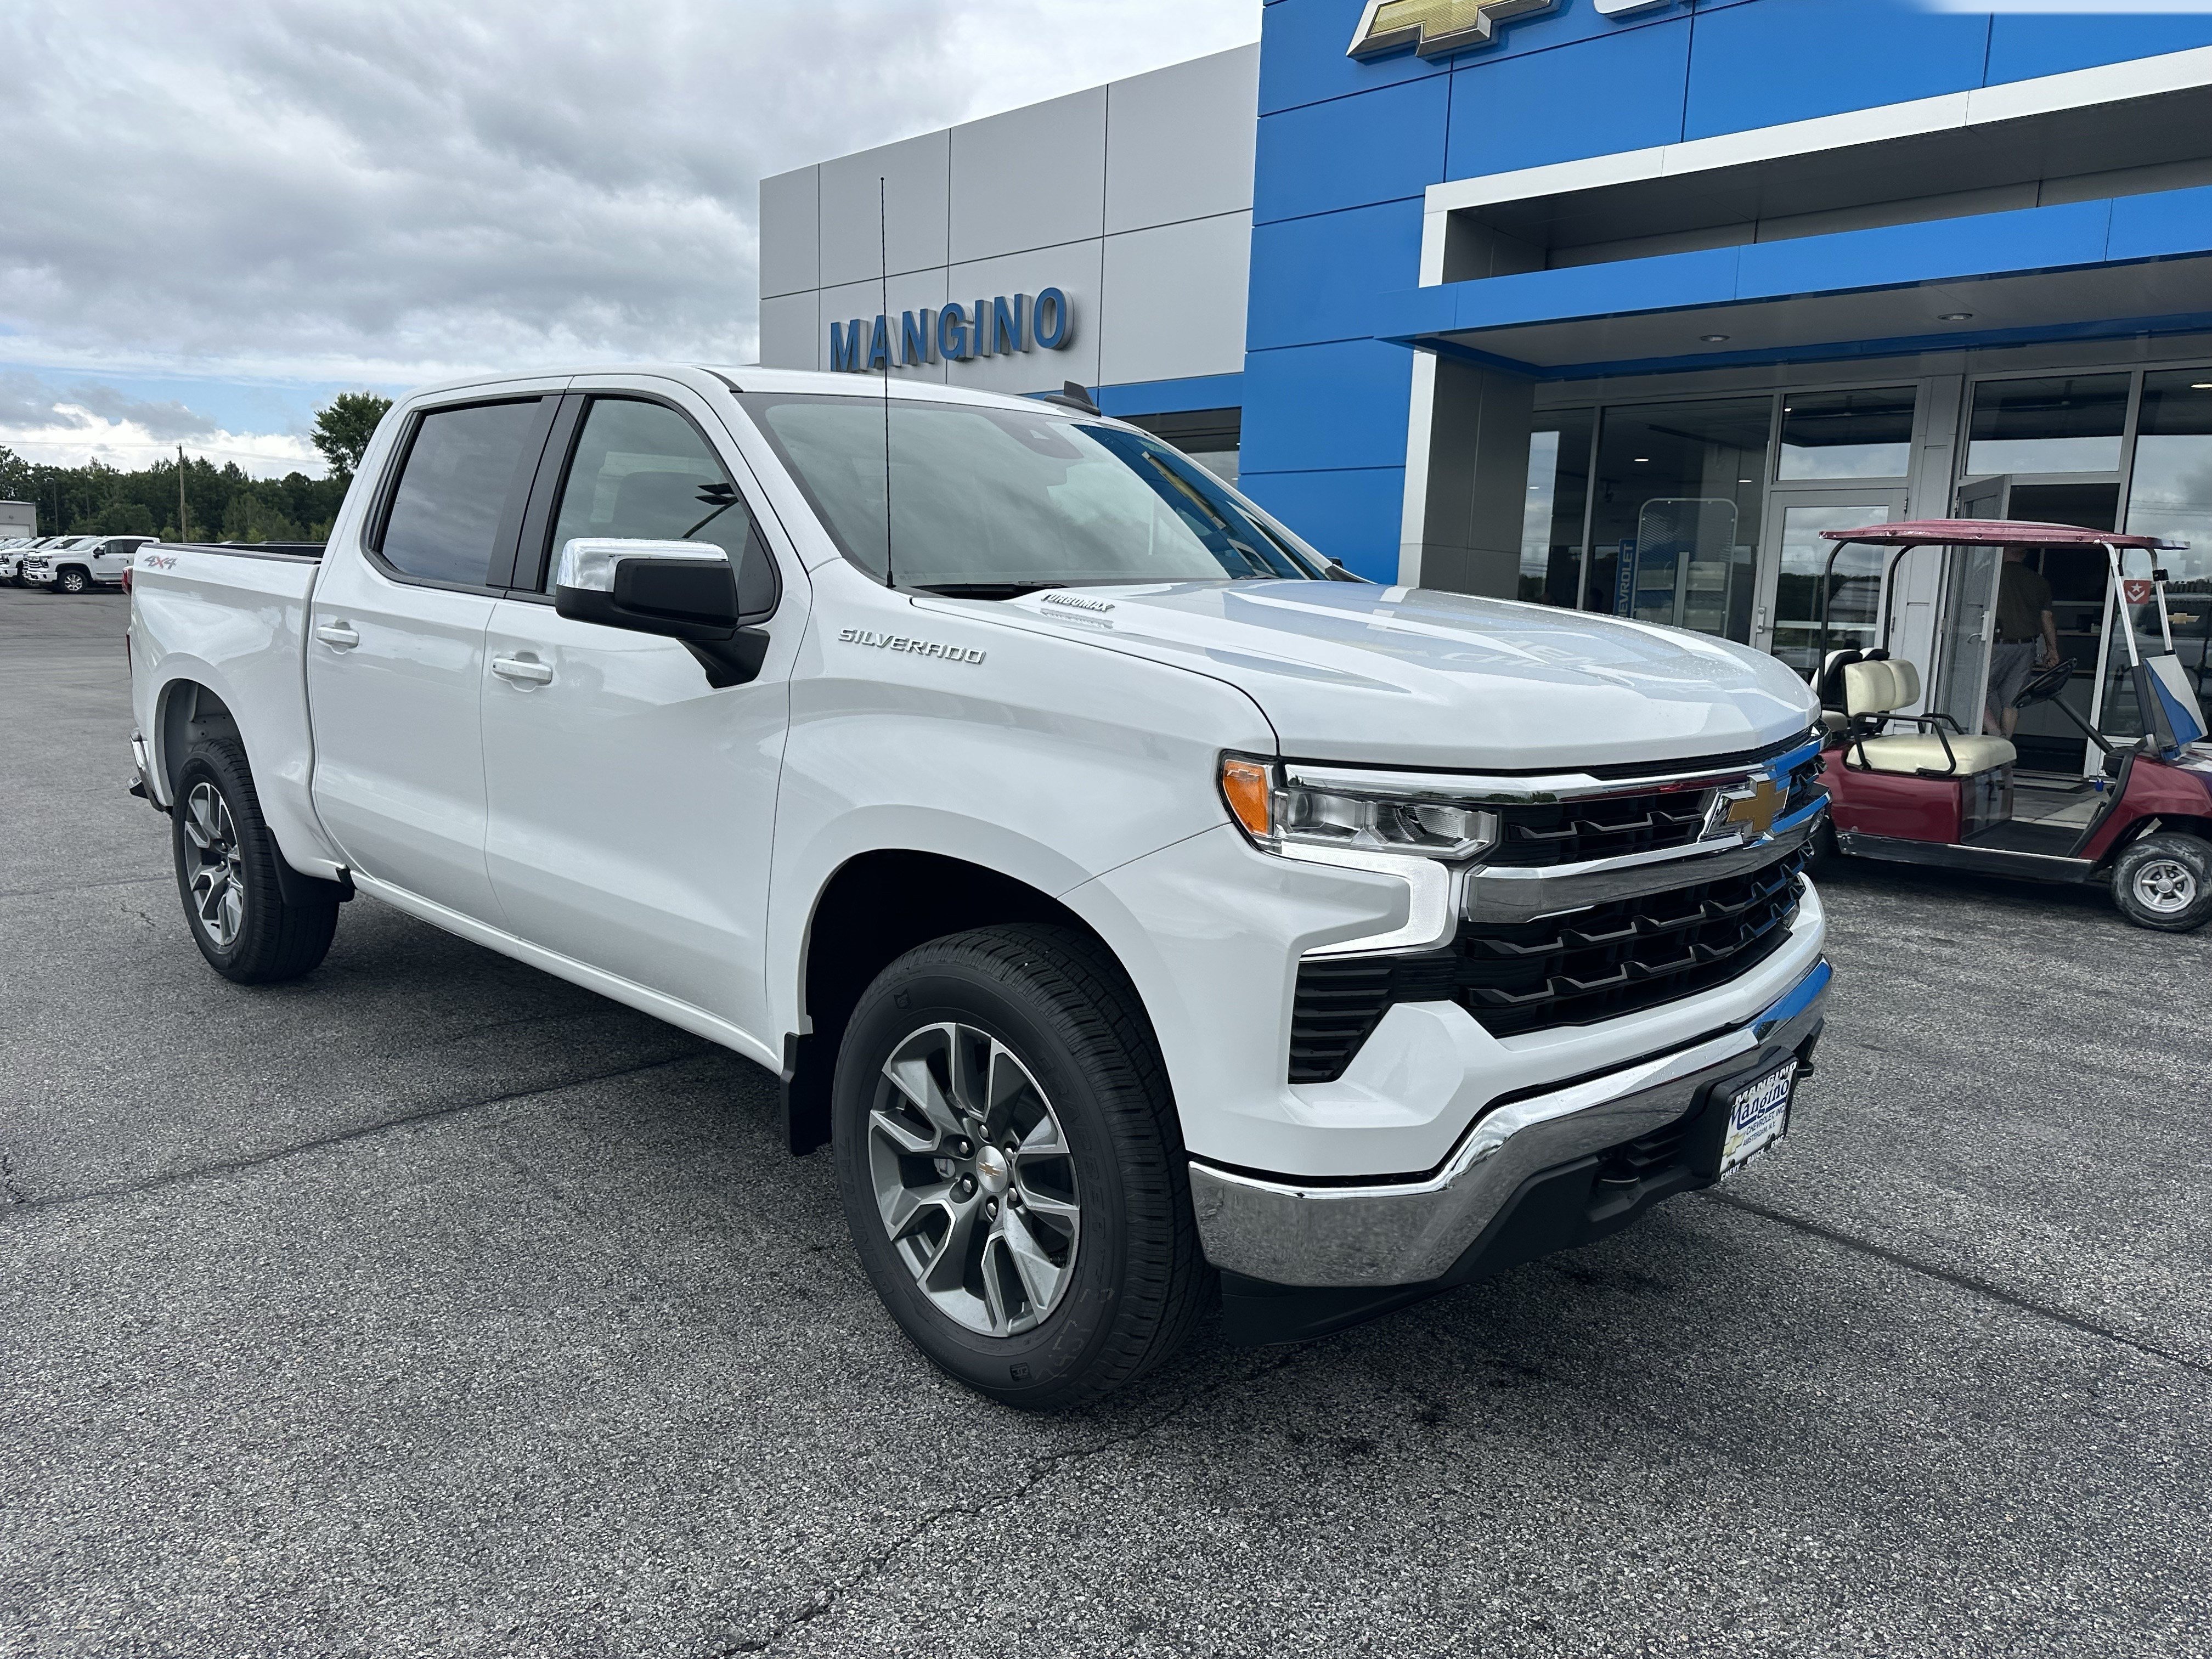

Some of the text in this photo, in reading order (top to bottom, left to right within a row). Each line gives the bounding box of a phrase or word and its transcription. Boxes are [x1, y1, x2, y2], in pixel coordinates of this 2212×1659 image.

[830, 287, 1070, 373] MANGINO
[1041, 594, 1115, 612] TURBOMAX
[1619, 544, 1633, 617] EVROLET
[838, 628, 986, 665] SILVERADO
[1730, 1079, 1790, 1130] Mangino
[1734, 1061, 1797, 1105] MANGINO
[1720, 1135, 1785, 1181] CHEVY BUICK GMC
